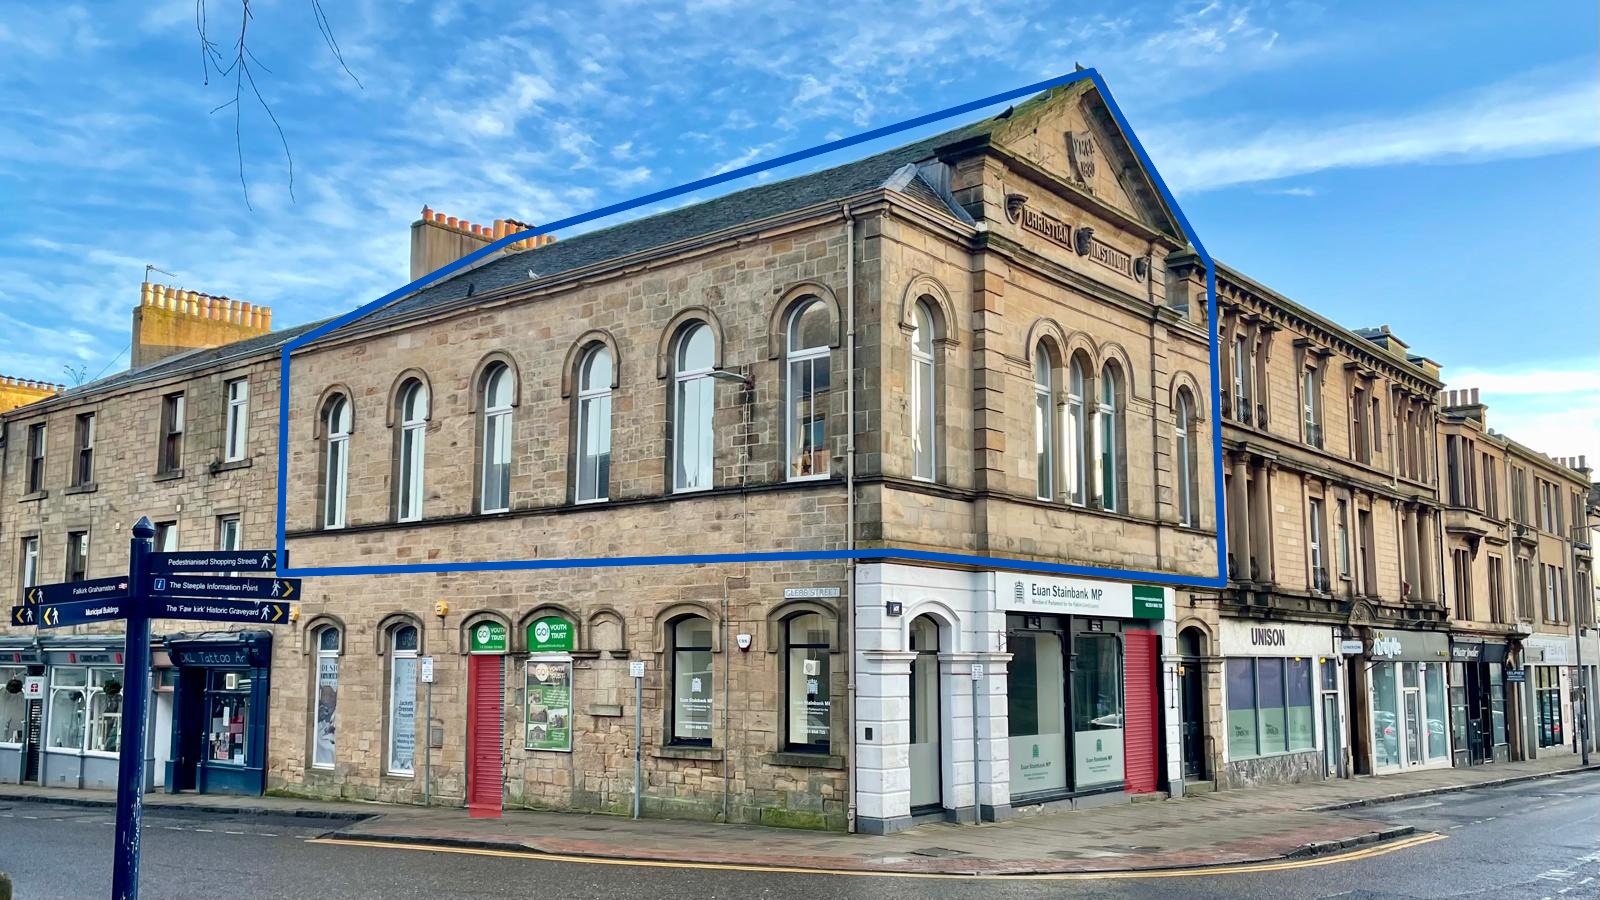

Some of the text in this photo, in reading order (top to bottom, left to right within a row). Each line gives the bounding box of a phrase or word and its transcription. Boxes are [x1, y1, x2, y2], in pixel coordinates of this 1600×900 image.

[1024, 209, 1070, 246] CHRISTIAN
[168, 557, 258, 567] Pedestrianised Shopping Streets
[88, 585, 116, 594] Grahamston
[170, 581, 258, 592] The Steeple Information Point
[1032, 583, 1103, 601] Euan Stainbank MP
[810, 588, 838, 597] STREET
[85, 605, 120, 617] Municipal Buildings
[166, 604, 177, 612] The
[206, 606, 228, 614] Historic
[229, 607, 259, 617] Graveyard
[1251, 627, 1285, 646] UNISON
[198, 652, 231, 663] Tattoo
